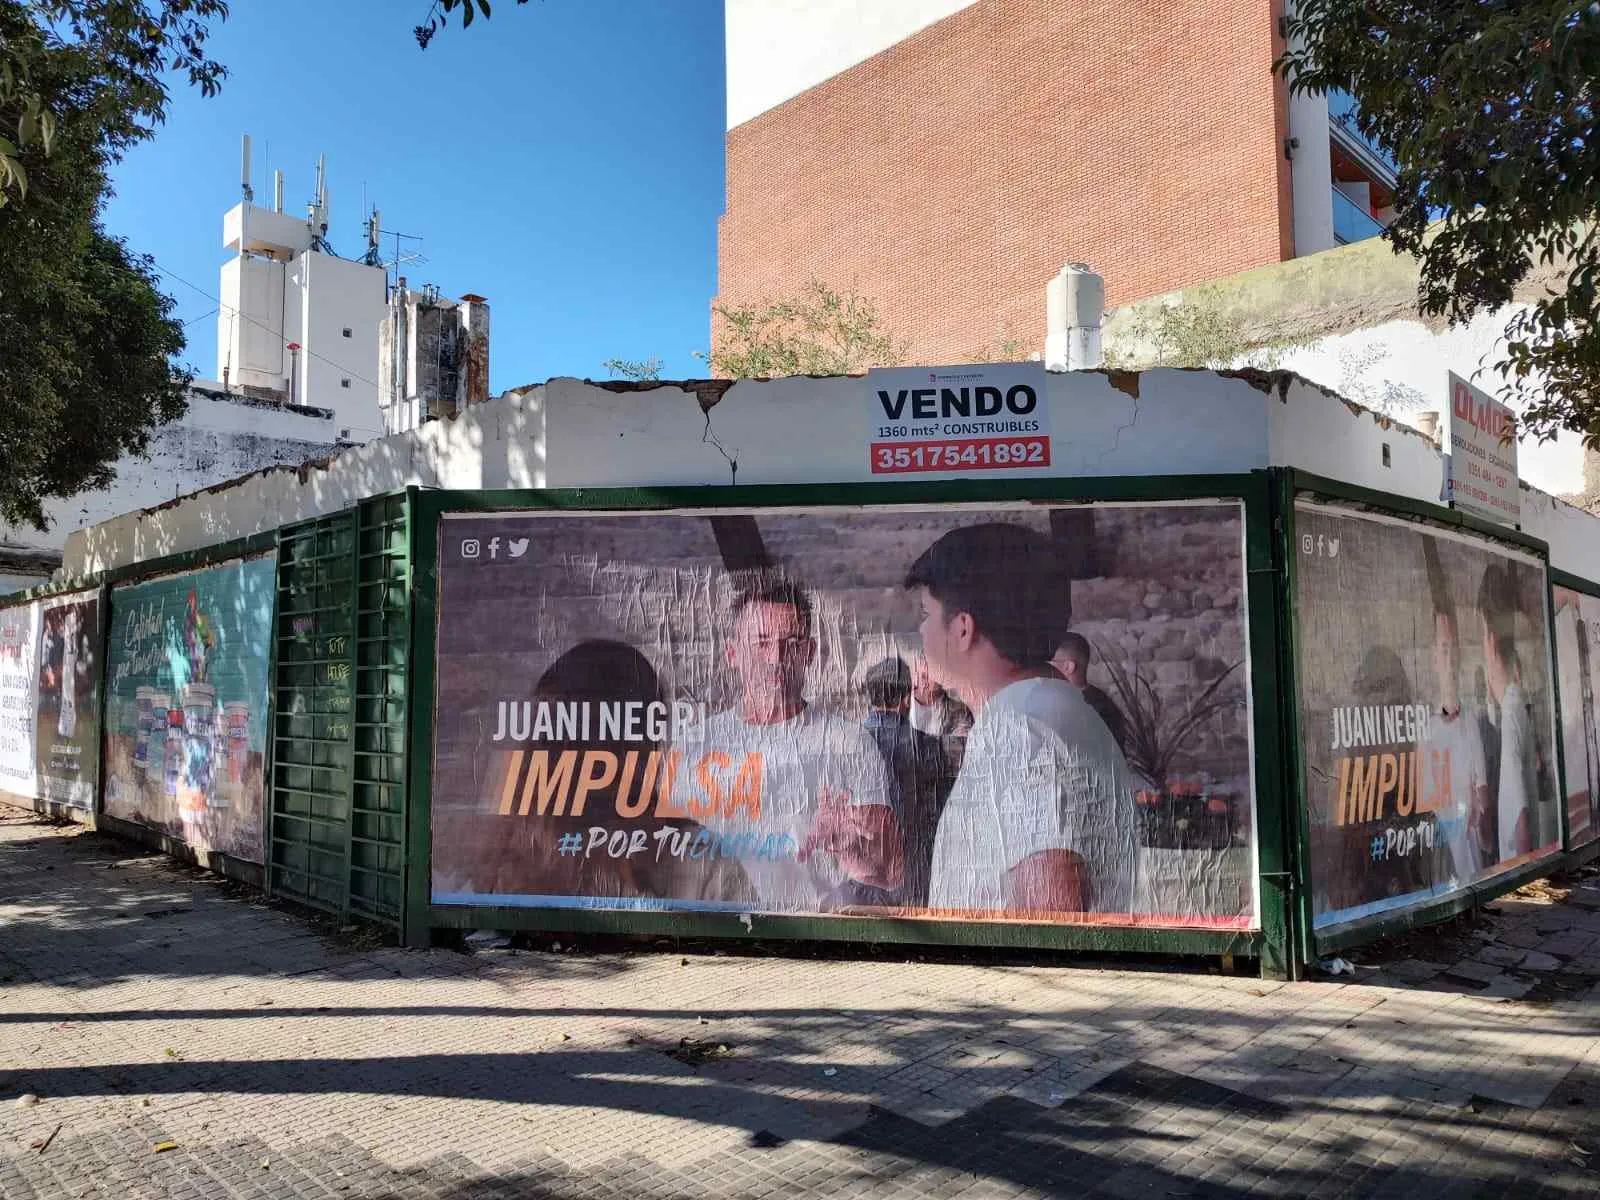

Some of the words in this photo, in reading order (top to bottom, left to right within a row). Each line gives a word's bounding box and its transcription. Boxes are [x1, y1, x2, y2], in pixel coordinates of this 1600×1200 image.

[878, 384, 1037, 420] VENDO
[879, 425, 907, 437] 1360
[944, 420, 1039, 435] CONSTRUIBLES
[878, 442, 1044, 468] 3517541892
[493, 701, 591, 741] JUANI
[600, 701, 706, 741] NEGRI
[1332, 706, 1381, 749] JUANI
[1384, 704, 1430, 744] NEGRI
[497, 750, 762, 820] IMPULSA
[1336, 747, 1454, 826] IMPULSA
